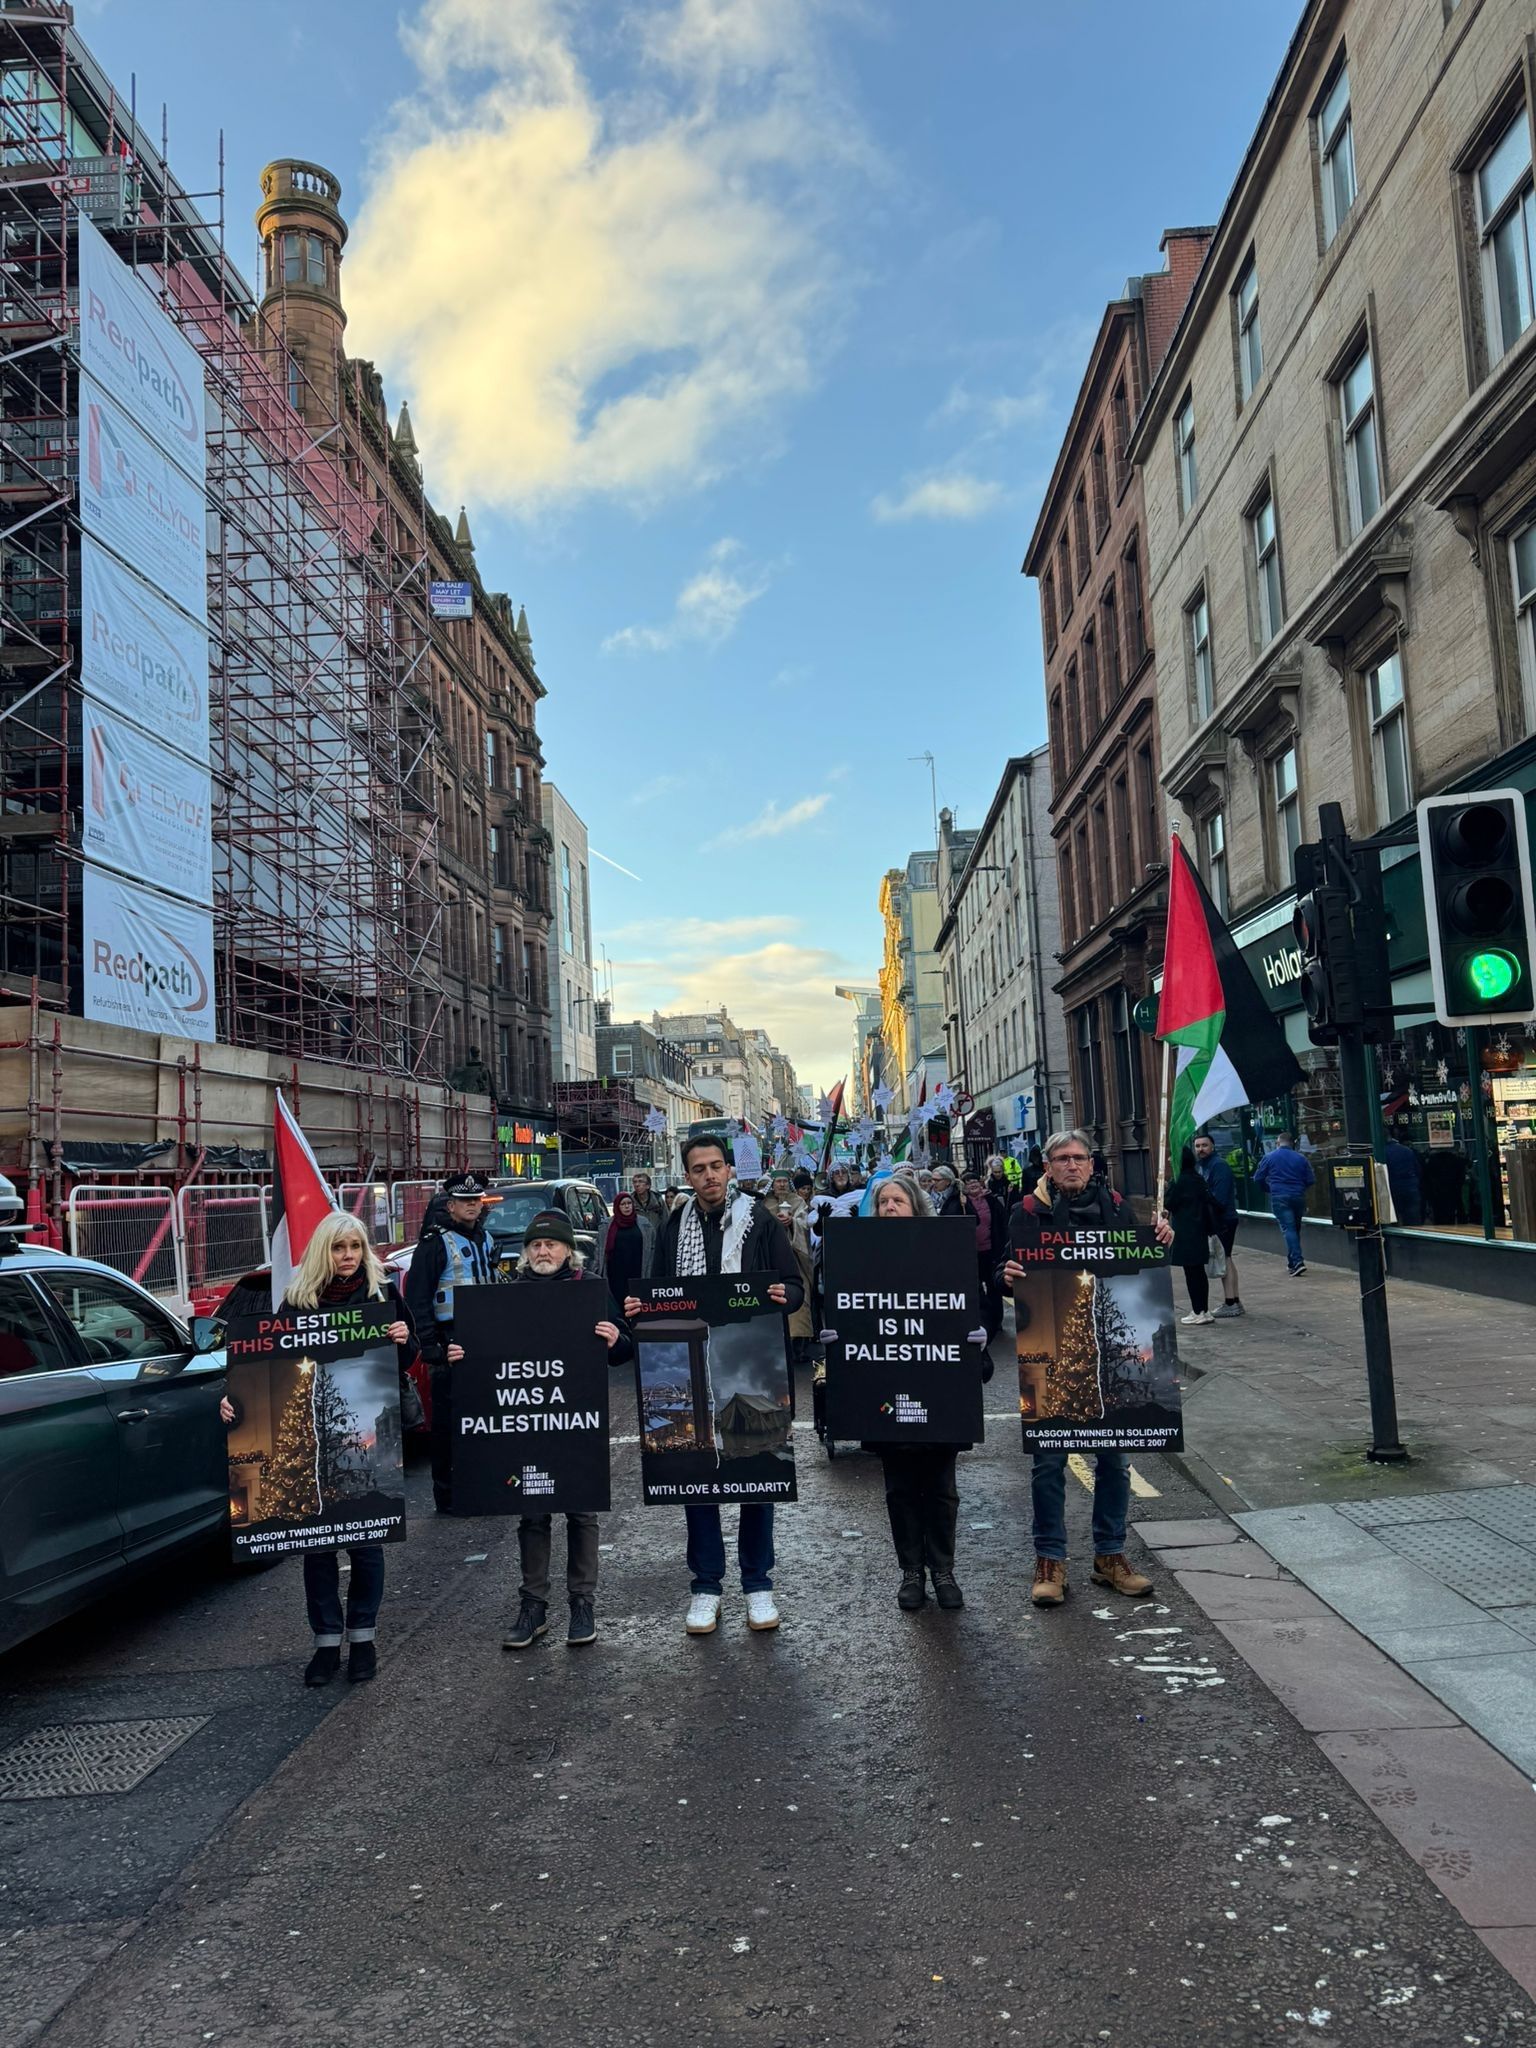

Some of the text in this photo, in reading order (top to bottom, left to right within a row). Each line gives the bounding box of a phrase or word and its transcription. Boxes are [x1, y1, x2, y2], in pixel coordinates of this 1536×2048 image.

[88, 287, 185, 421] Redpath
[147, 482, 200, 547] CLYDE
[91, 607, 187, 705] Redpath
[150, 783, 205, 828] CLYDE
[93, 938, 192, 997] Redpath
[1040, 1230, 1137, 1244] PALESTINE
[1015, 1246, 1165, 1261] THIS CHRISTMAS
[652, 1287, 683, 1298] FROM
[734, 1283, 750, 1294] TO
[641, 1300, 697, 1313] GLASGOW
[728, 1297, 760, 1308] GAZA
[837, 1292, 966, 1310] BETHLEHEM
[258, 1309, 363, 1334] PALESTINE
[879, 1318, 924, 1336] IS IN
[230, 1323, 391, 1355] THIS CHRISTMAS
[845, 1343, 961, 1362] PALESTINE
[495, 1360, 564, 1380] JESUS
[496, 1386, 565, 1407] WAS A
[895, 1408, 928, 1416] EMERGENCY
[461, 1410, 600, 1435] PALESTINIAN
[1025, 1428, 1179, 1438] GLASGOW TWINNED IN SOLIDARITY
[1039, 1439, 1167, 1448] WITH BETHLEHEM SINCE 2007
[522, 1465, 537, 1473] GAZA
[522, 1472, 549, 1480] GENOCIDE
[522, 1479, 555, 1488] EMERGENCY
[522, 1487, 555, 1495] COMMITTEE
[648, 1482, 791, 1495] WITH LOVE & SOLIDARITY
[236, 1516, 402, 1545] GLASGOW TWINNED IN SOLIDARITY
[250, 1529, 389, 1555] WITH BETHLEHEM SINCE 2007
